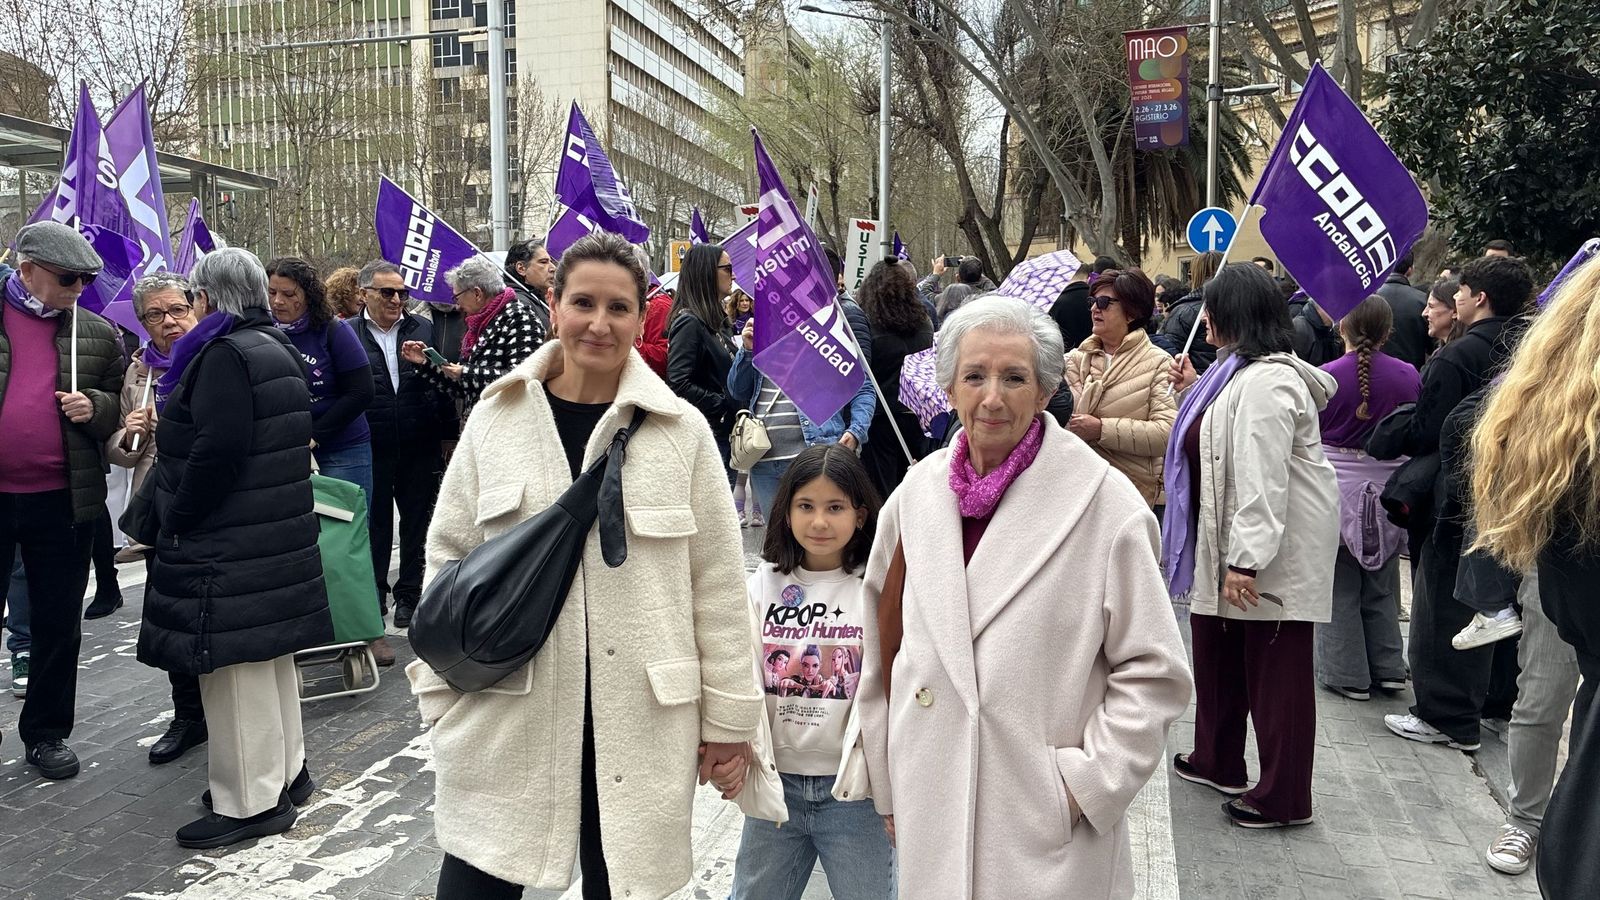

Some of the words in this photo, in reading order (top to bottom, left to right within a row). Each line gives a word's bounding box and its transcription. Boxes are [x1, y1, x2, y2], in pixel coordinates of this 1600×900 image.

[1129, 36, 1178, 61] MAO
[1154, 103, 1178, 112] 27.3.26
[1289, 119, 1387, 248] CCOO
[1312, 212, 1372, 290] Andalucía
[780, 302, 855, 377] igualdad
[765, 603, 827, 627] KPOP
[812, 621, 863, 640] Hunters
